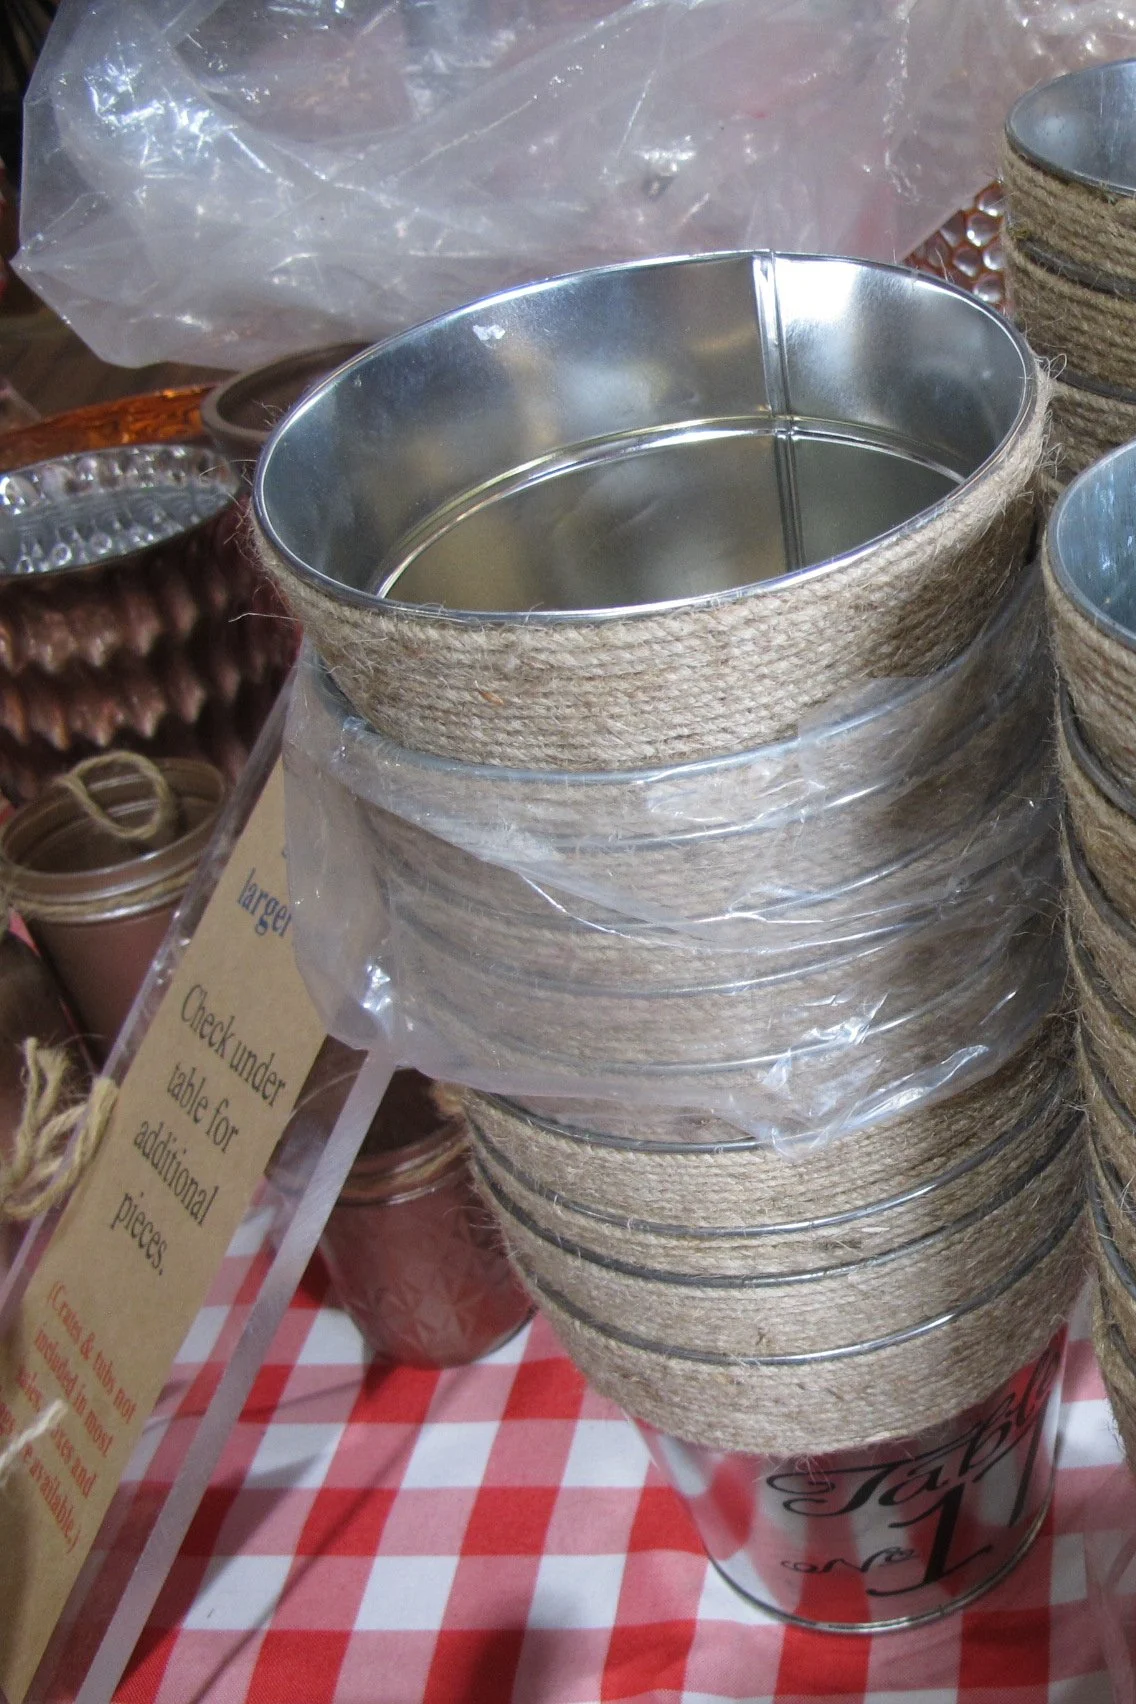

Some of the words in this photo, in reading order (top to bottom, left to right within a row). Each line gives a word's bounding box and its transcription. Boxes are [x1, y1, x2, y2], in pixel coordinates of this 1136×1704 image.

[180, 984, 236, 1060] Check
[229, 1040, 287, 1108] under
[166, 1061, 209, 1125] table
[204, 1097, 239, 1154] for
[133, 1119, 219, 1229] additional
[109, 1190, 168, 1277] pieces.
[34, 1328, 79, 1401] included
[72, 1383, 87, 1417] in
[83, 1409, 114, 1458] most
[92, 1349, 116, 1396] tubs
[113, 1386, 138, 1425] not
[70, 1456, 98, 1500] and
